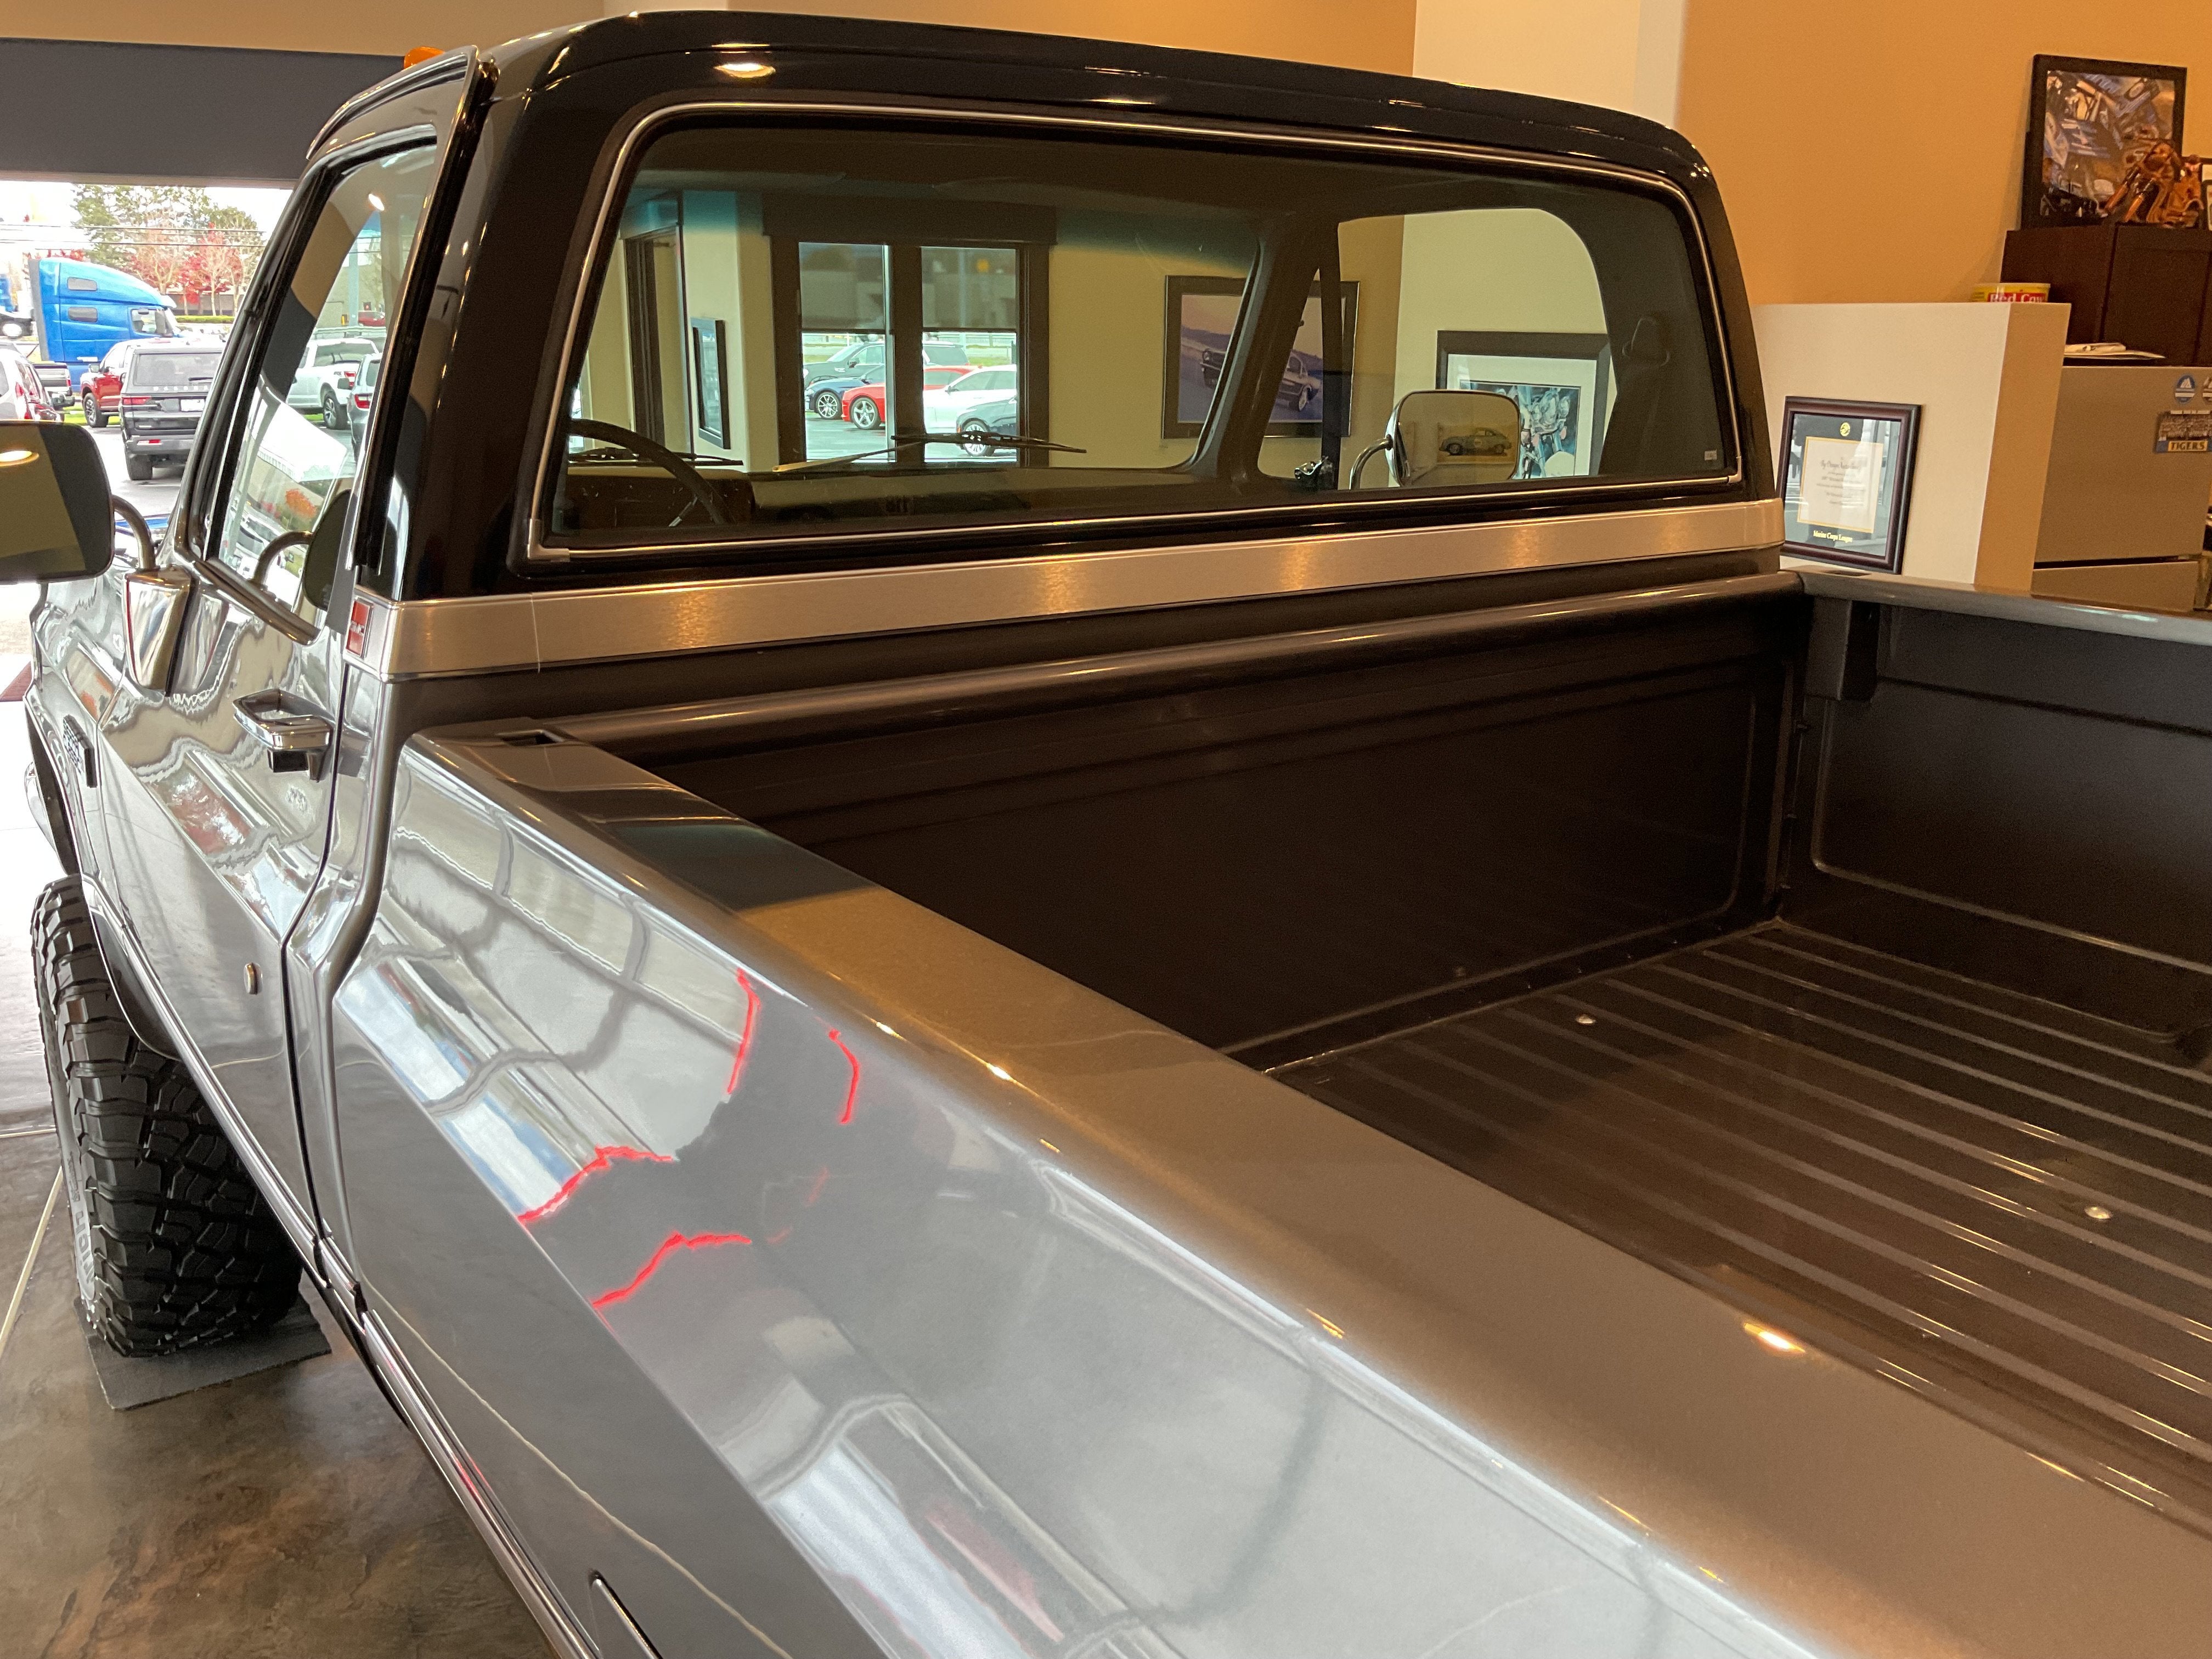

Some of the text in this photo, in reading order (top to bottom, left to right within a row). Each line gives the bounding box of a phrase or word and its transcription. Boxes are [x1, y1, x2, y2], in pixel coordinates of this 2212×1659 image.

[1990, 293, 2017, 302] Red
[2171, 441, 2204, 450] TIGERS
[350, 620, 365, 636] GMC
